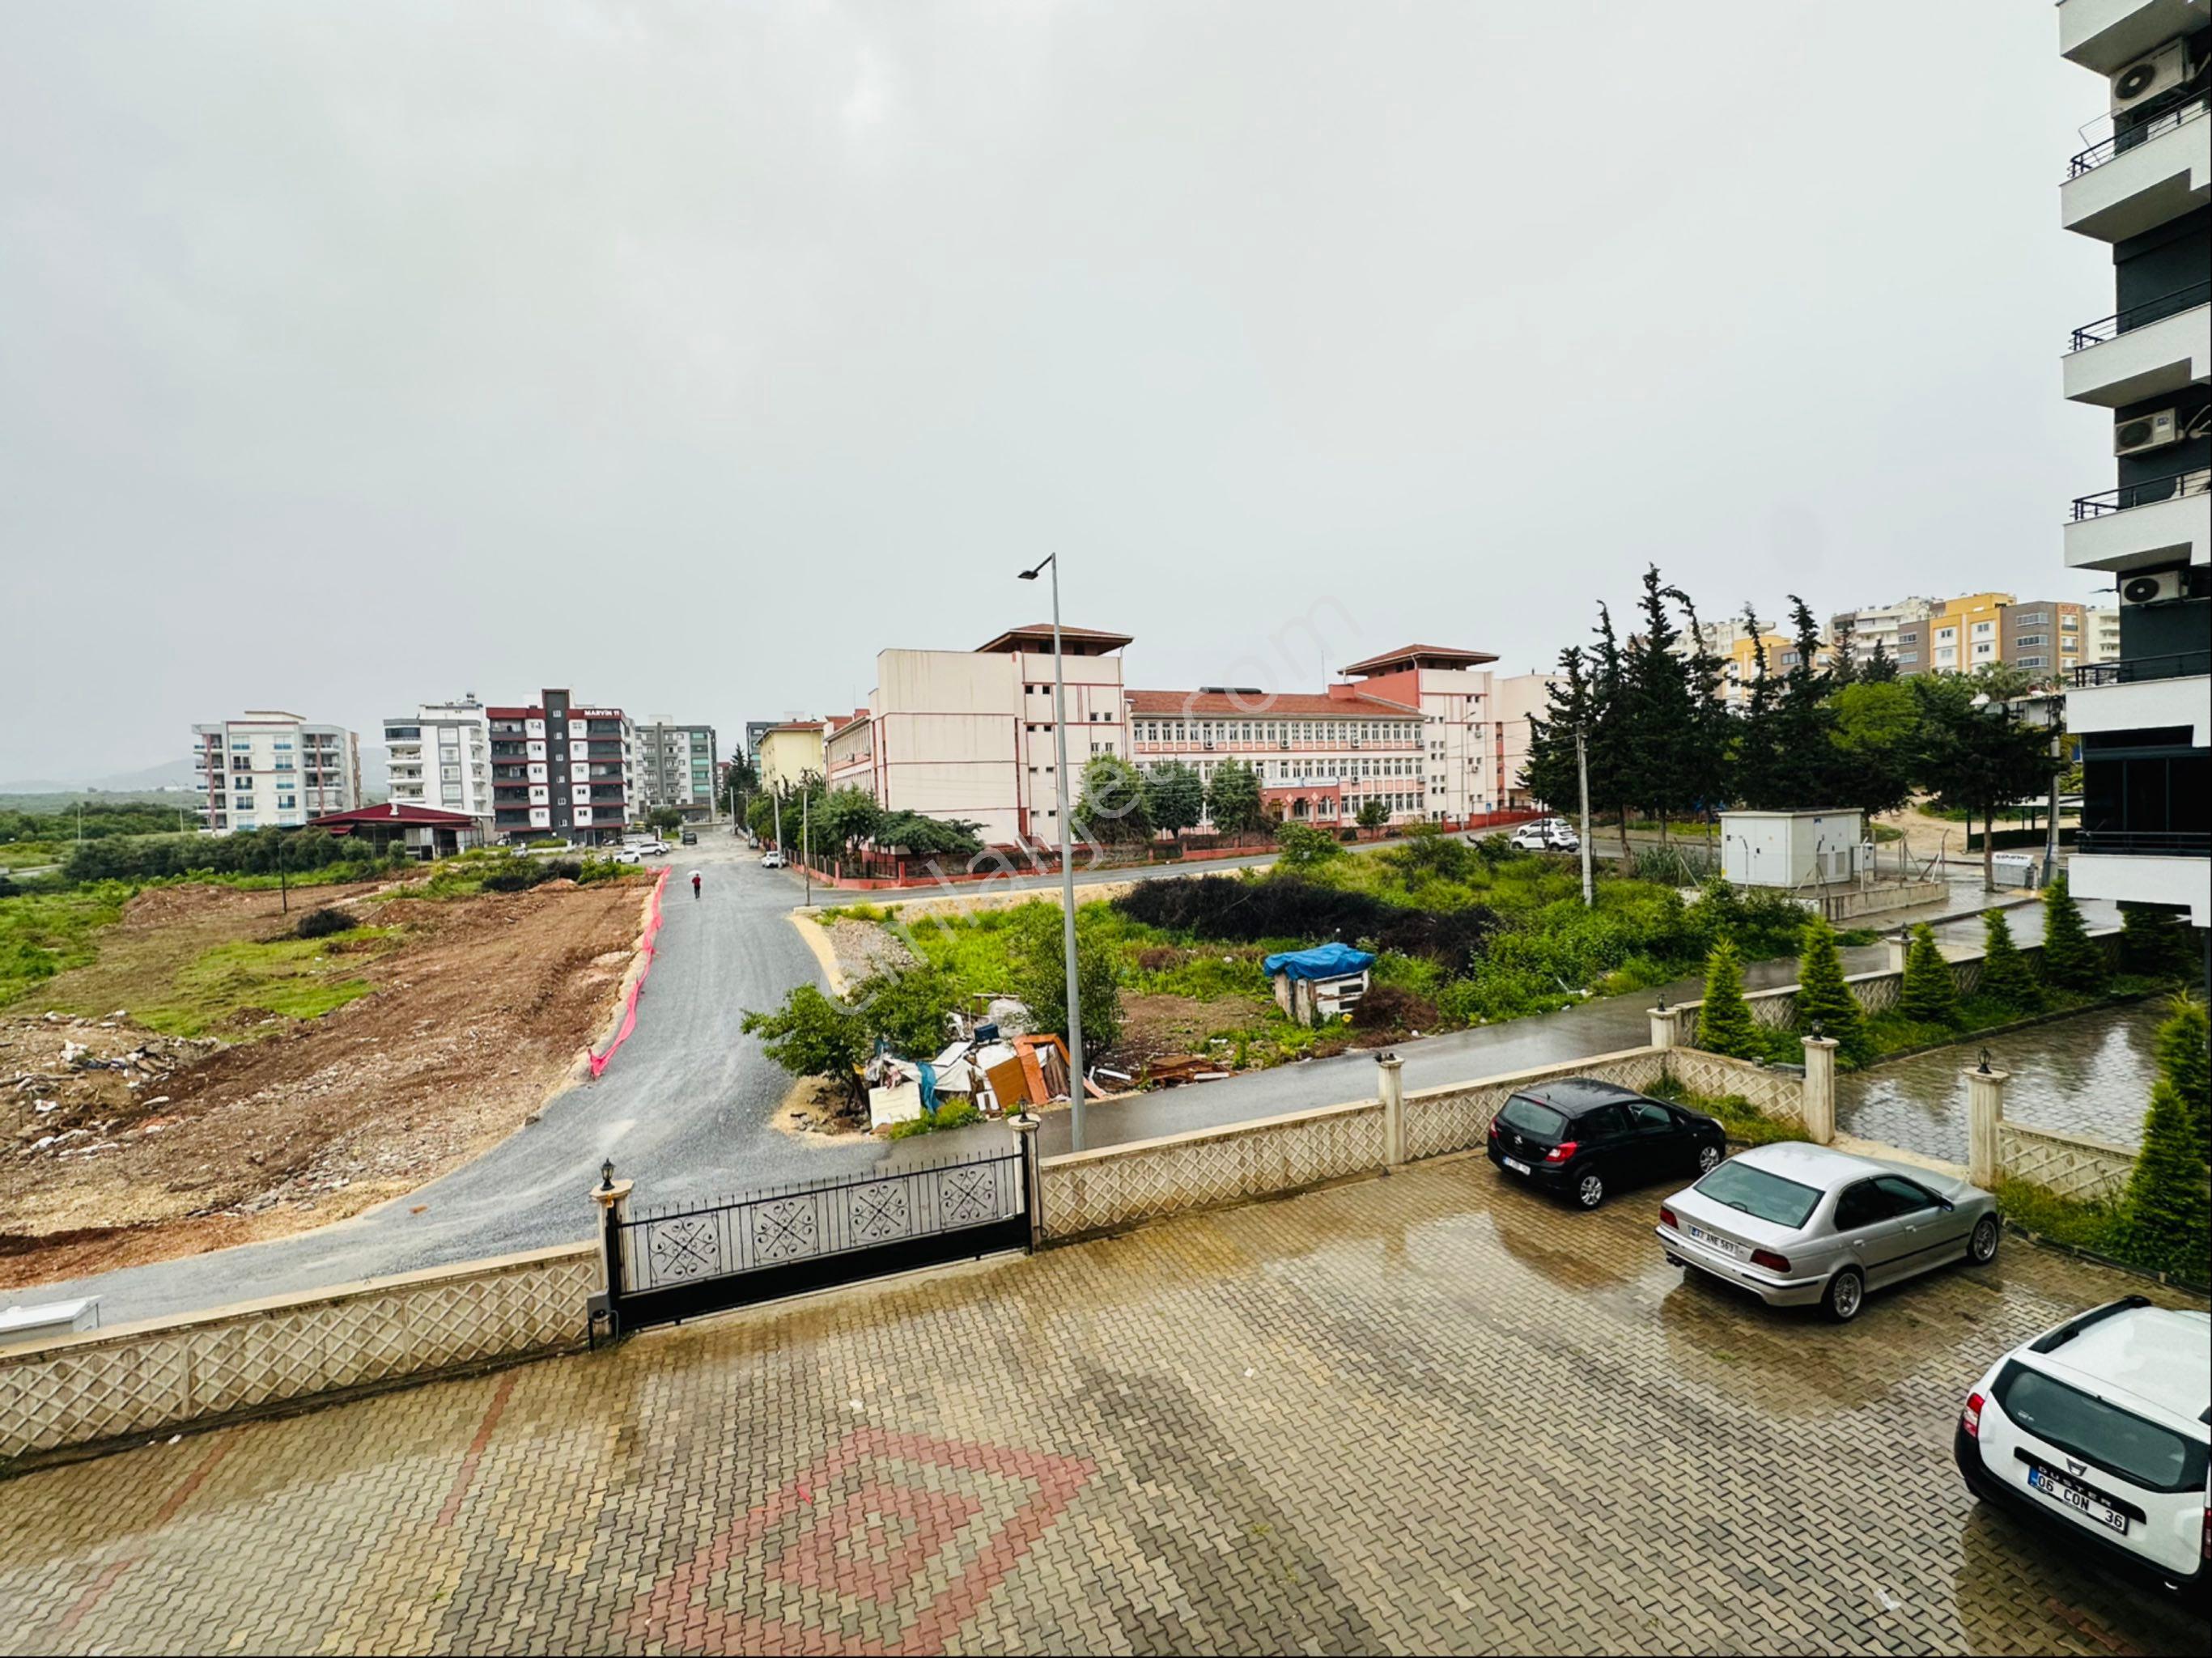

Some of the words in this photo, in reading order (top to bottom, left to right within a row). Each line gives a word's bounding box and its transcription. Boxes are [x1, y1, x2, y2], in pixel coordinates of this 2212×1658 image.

[2038, 1465, 2112, 1507] DUSTER
[2038, 1475, 2054, 1492] 06
[2063, 1488, 2090, 1511] CON
[2104, 1509, 2124, 1529] 36
